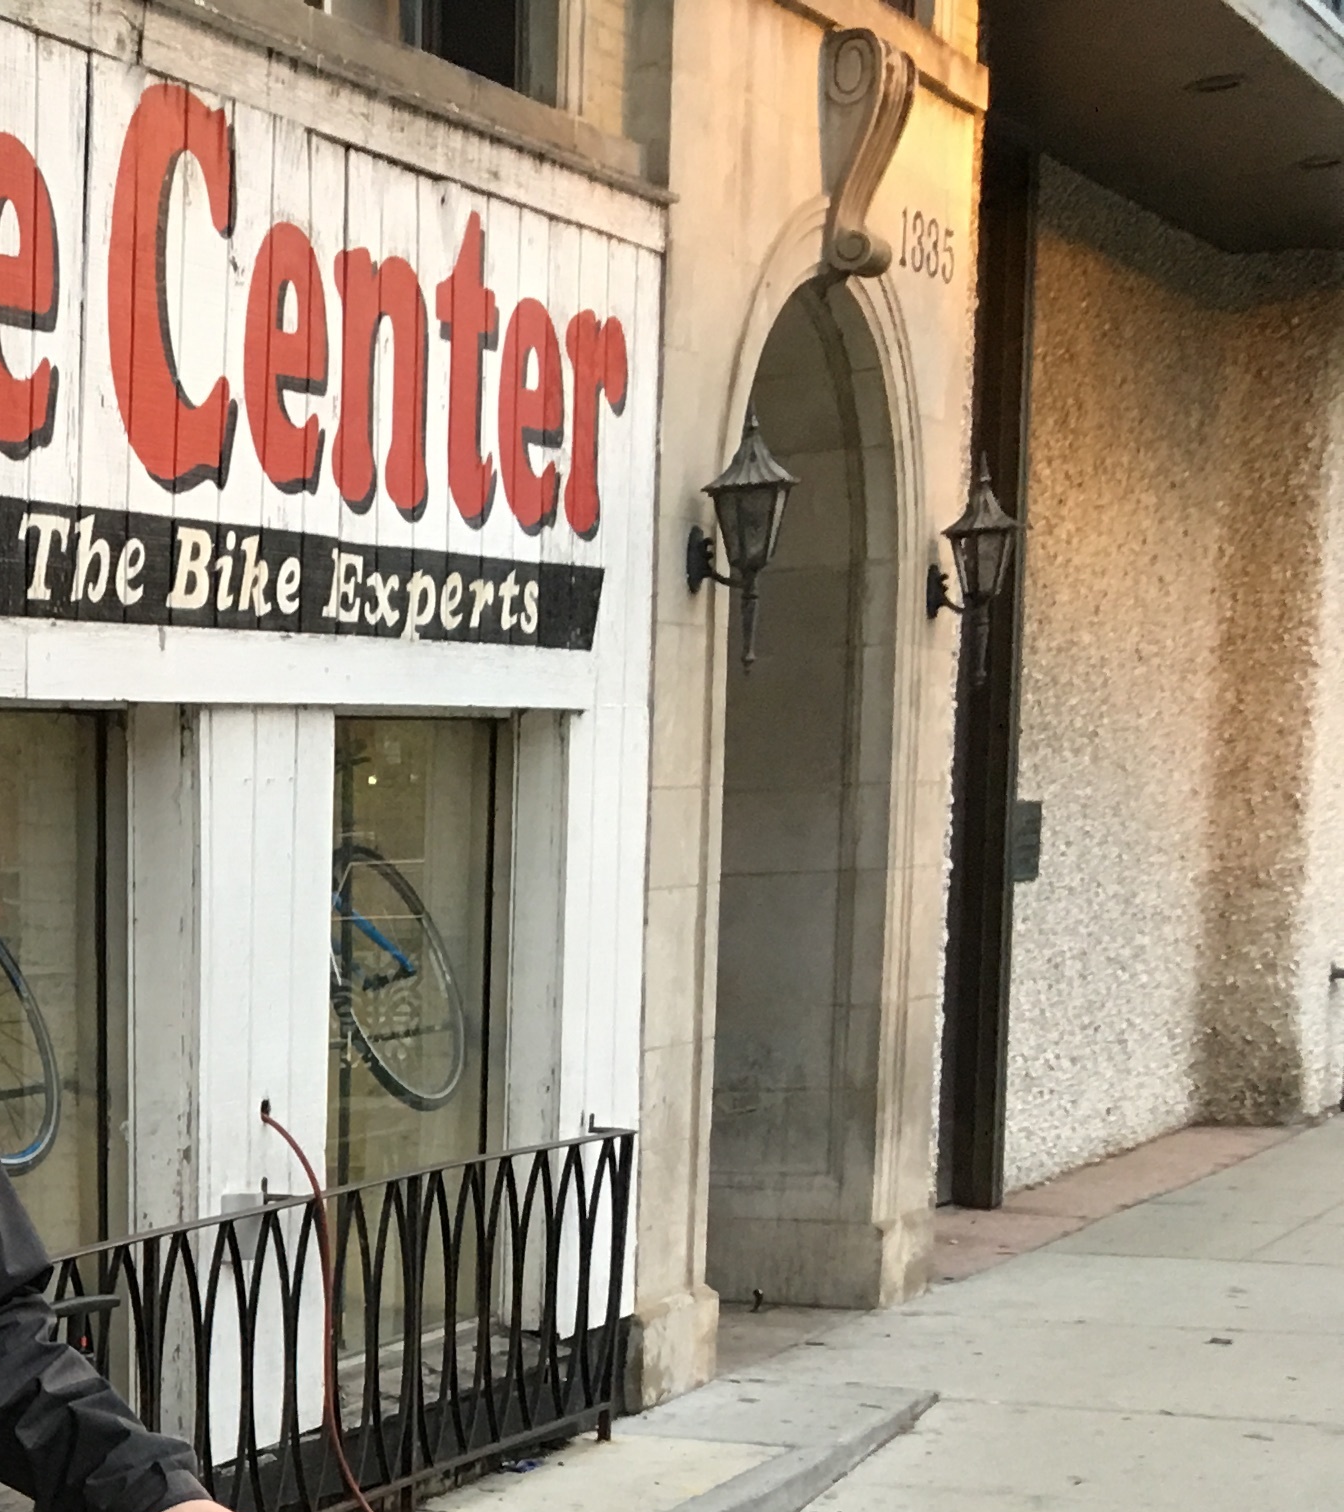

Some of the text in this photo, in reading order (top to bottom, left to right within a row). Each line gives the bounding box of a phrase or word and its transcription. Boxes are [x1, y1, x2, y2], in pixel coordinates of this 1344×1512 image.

[898, 206, 955, 284] 1335
[110, 82, 628, 542] Center
[18, 512, 540, 641] The Bike Experts
